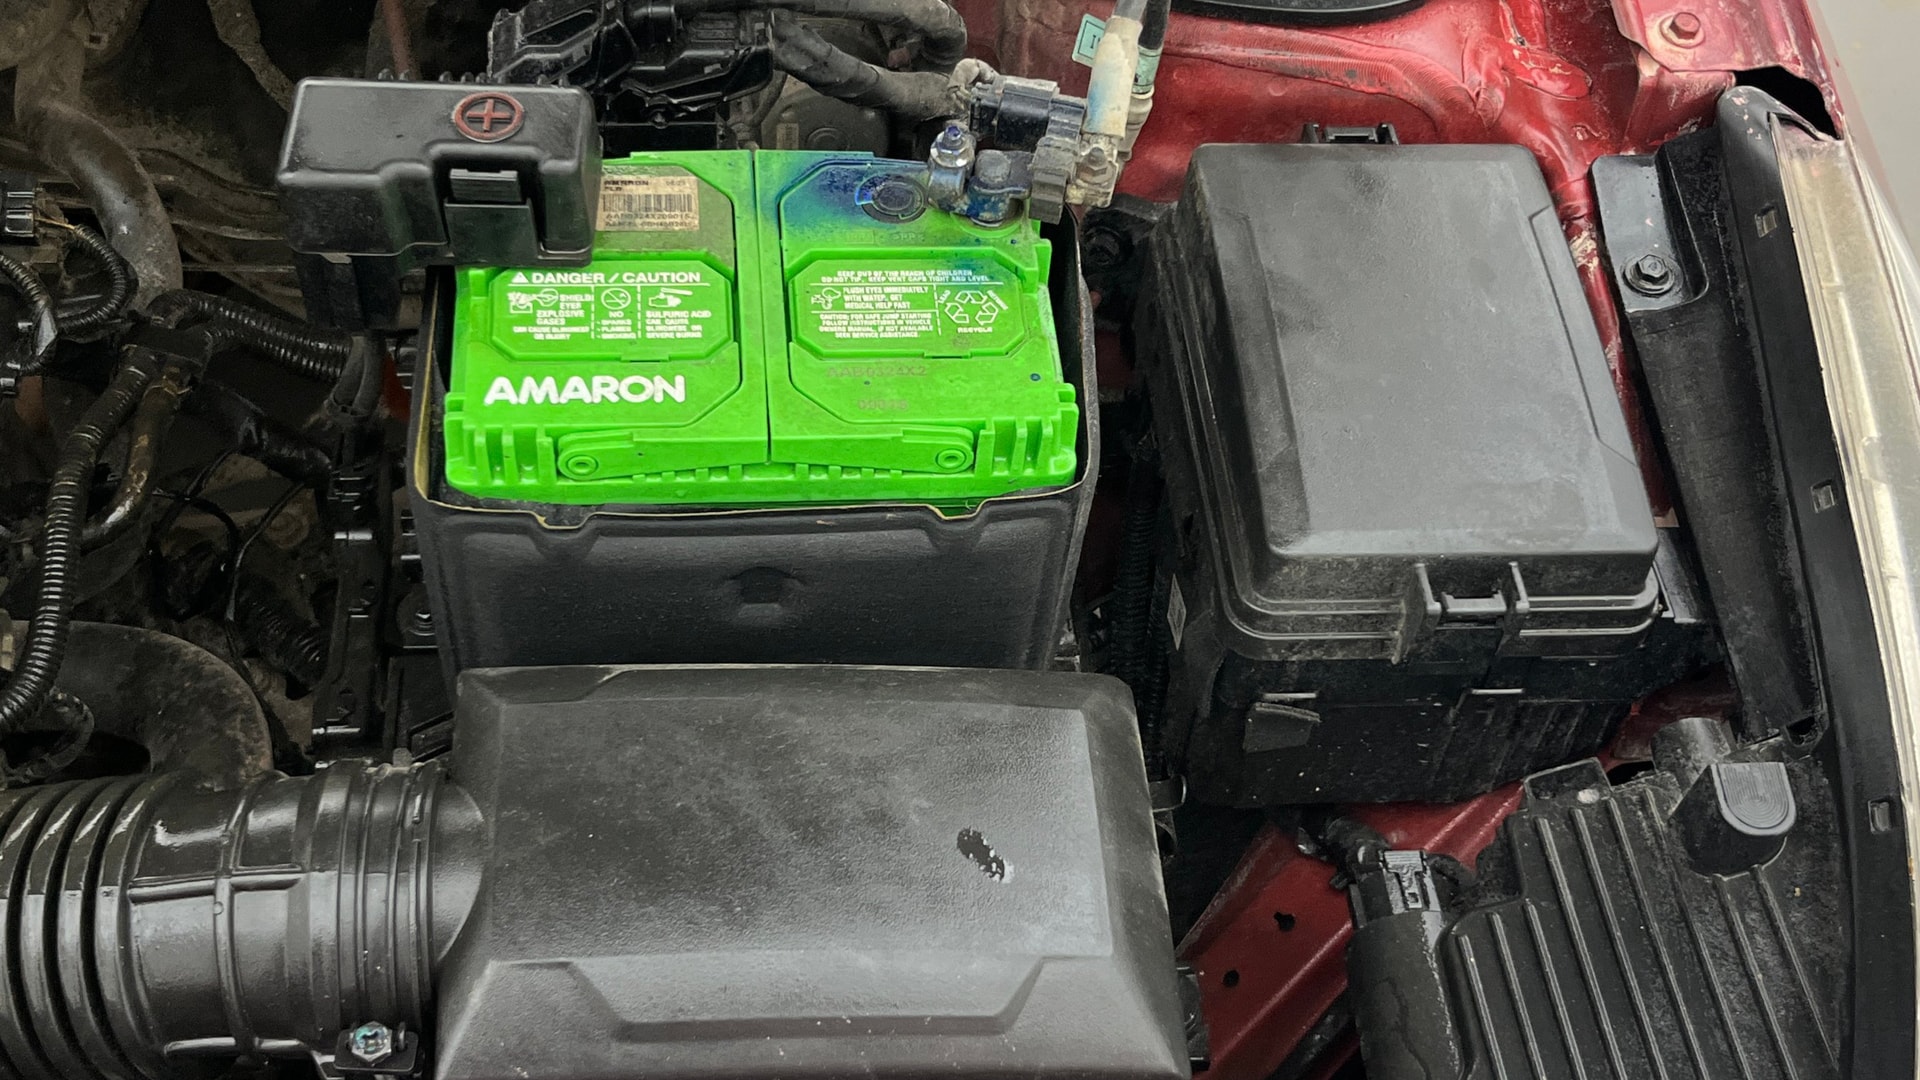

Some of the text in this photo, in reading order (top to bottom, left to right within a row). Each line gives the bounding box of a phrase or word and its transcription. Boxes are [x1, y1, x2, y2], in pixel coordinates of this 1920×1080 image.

[531, 272, 605, 284] DANGER
[622, 271, 701, 284] CAUTION
[536, 309, 585, 318] EXPLOSIVE
[608, 310, 624, 318] NO
[484, 374, 686, 405] AMARON
